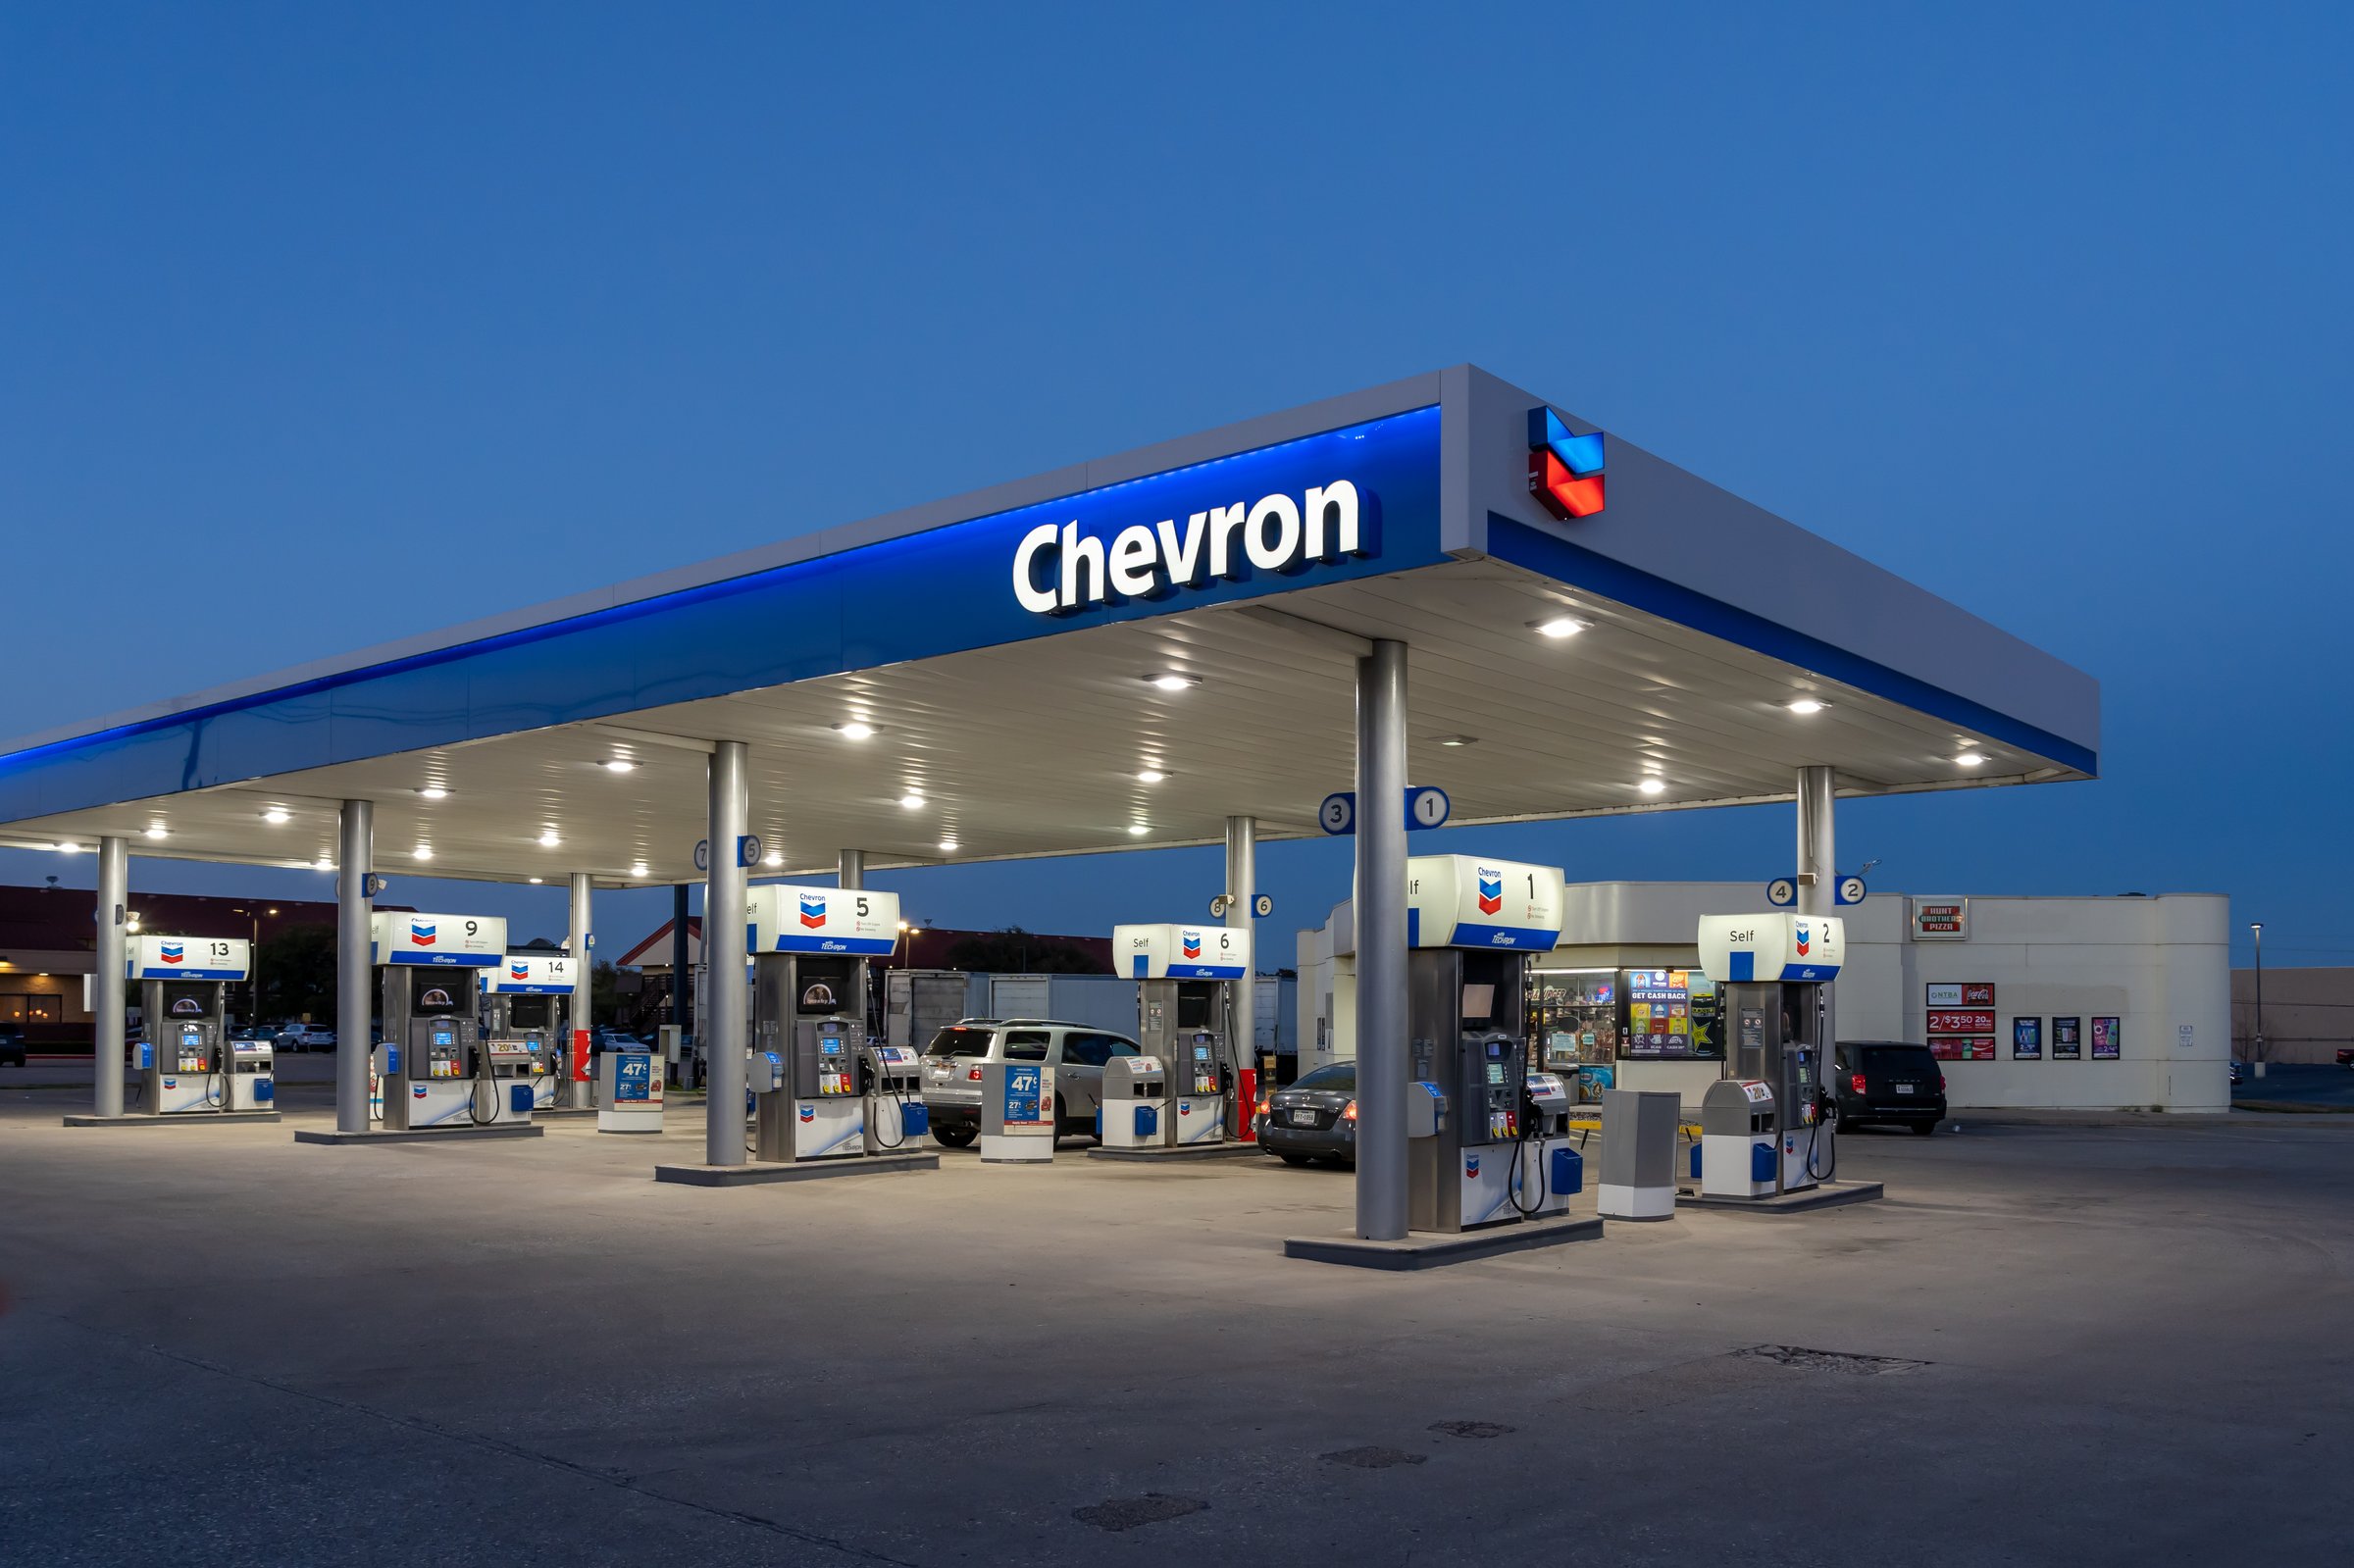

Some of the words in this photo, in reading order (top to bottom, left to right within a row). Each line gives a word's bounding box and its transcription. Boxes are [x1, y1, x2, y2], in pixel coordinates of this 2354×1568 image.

[1012, 480, 1359, 614] Chevron
[1330, 804, 1342, 823] 3
[1426, 797, 1433, 817] 1
[699, 848, 706, 862] 7
[747, 843, 755, 857] 5
[1478, 867, 1502, 879] Chevron
[369, 880, 376, 889] 9
[1527, 873, 1534, 899] 1
[1847, 884, 1858, 896] 2
[799, 893, 826, 902] Chevron
[1775, 885, 1787, 898] 4
[746, 902, 757, 915] elf
[856, 897, 869, 917] 5
[1214, 902, 1221, 913] 8
[1260, 900, 1267, 911] 6
[465, 920, 478, 936] 9
[1822, 923, 1830, 943] 2
[1134, 938, 1149, 948] Self
[1220, 933, 1229, 949] 6
[1492, 935, 1516, 946] TECHRON
[1729, 931, 1755, 942] Self
[210, 942, 230, 956] 13
[548, 961, 564, 974] 14
